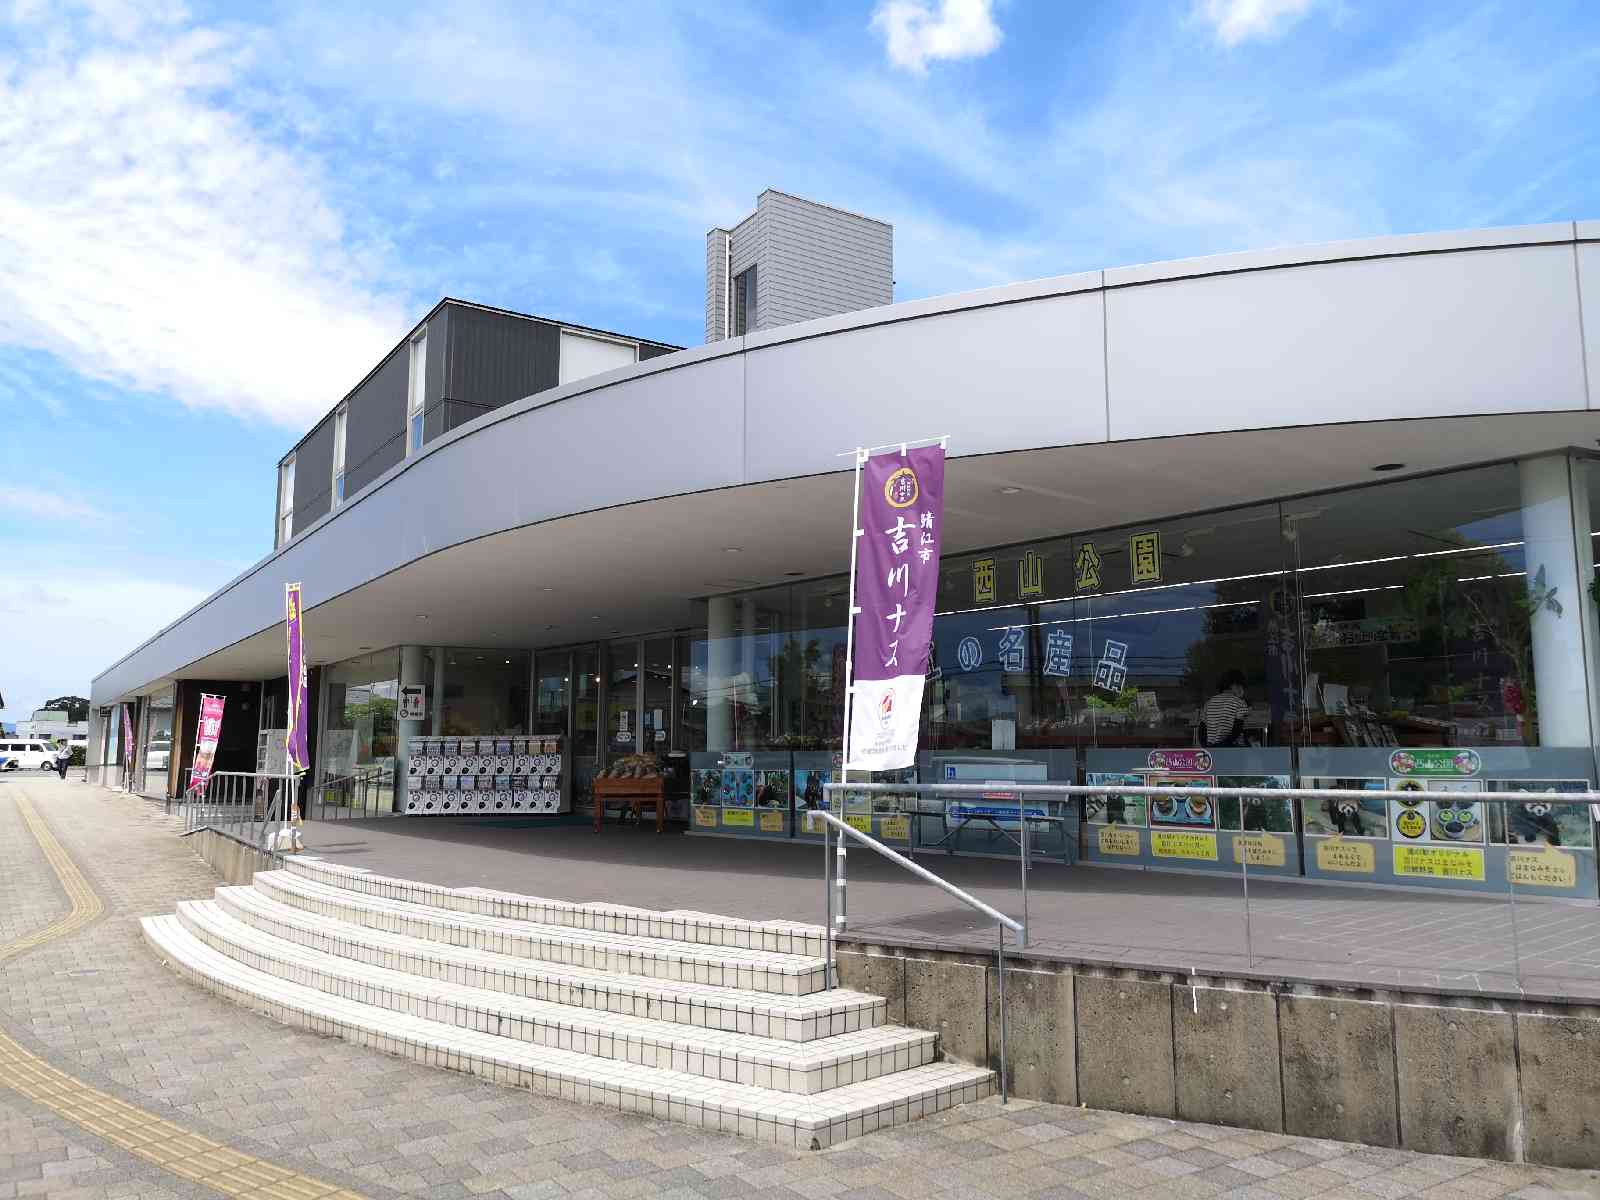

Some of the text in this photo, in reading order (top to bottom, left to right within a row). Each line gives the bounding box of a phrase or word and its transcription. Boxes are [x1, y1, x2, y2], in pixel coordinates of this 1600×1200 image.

[917, 511, 935, 565] 鯖江市
[971, 531, 1162, 603] 西山公園
[884, 516, 916, 668] 吉川ナス
